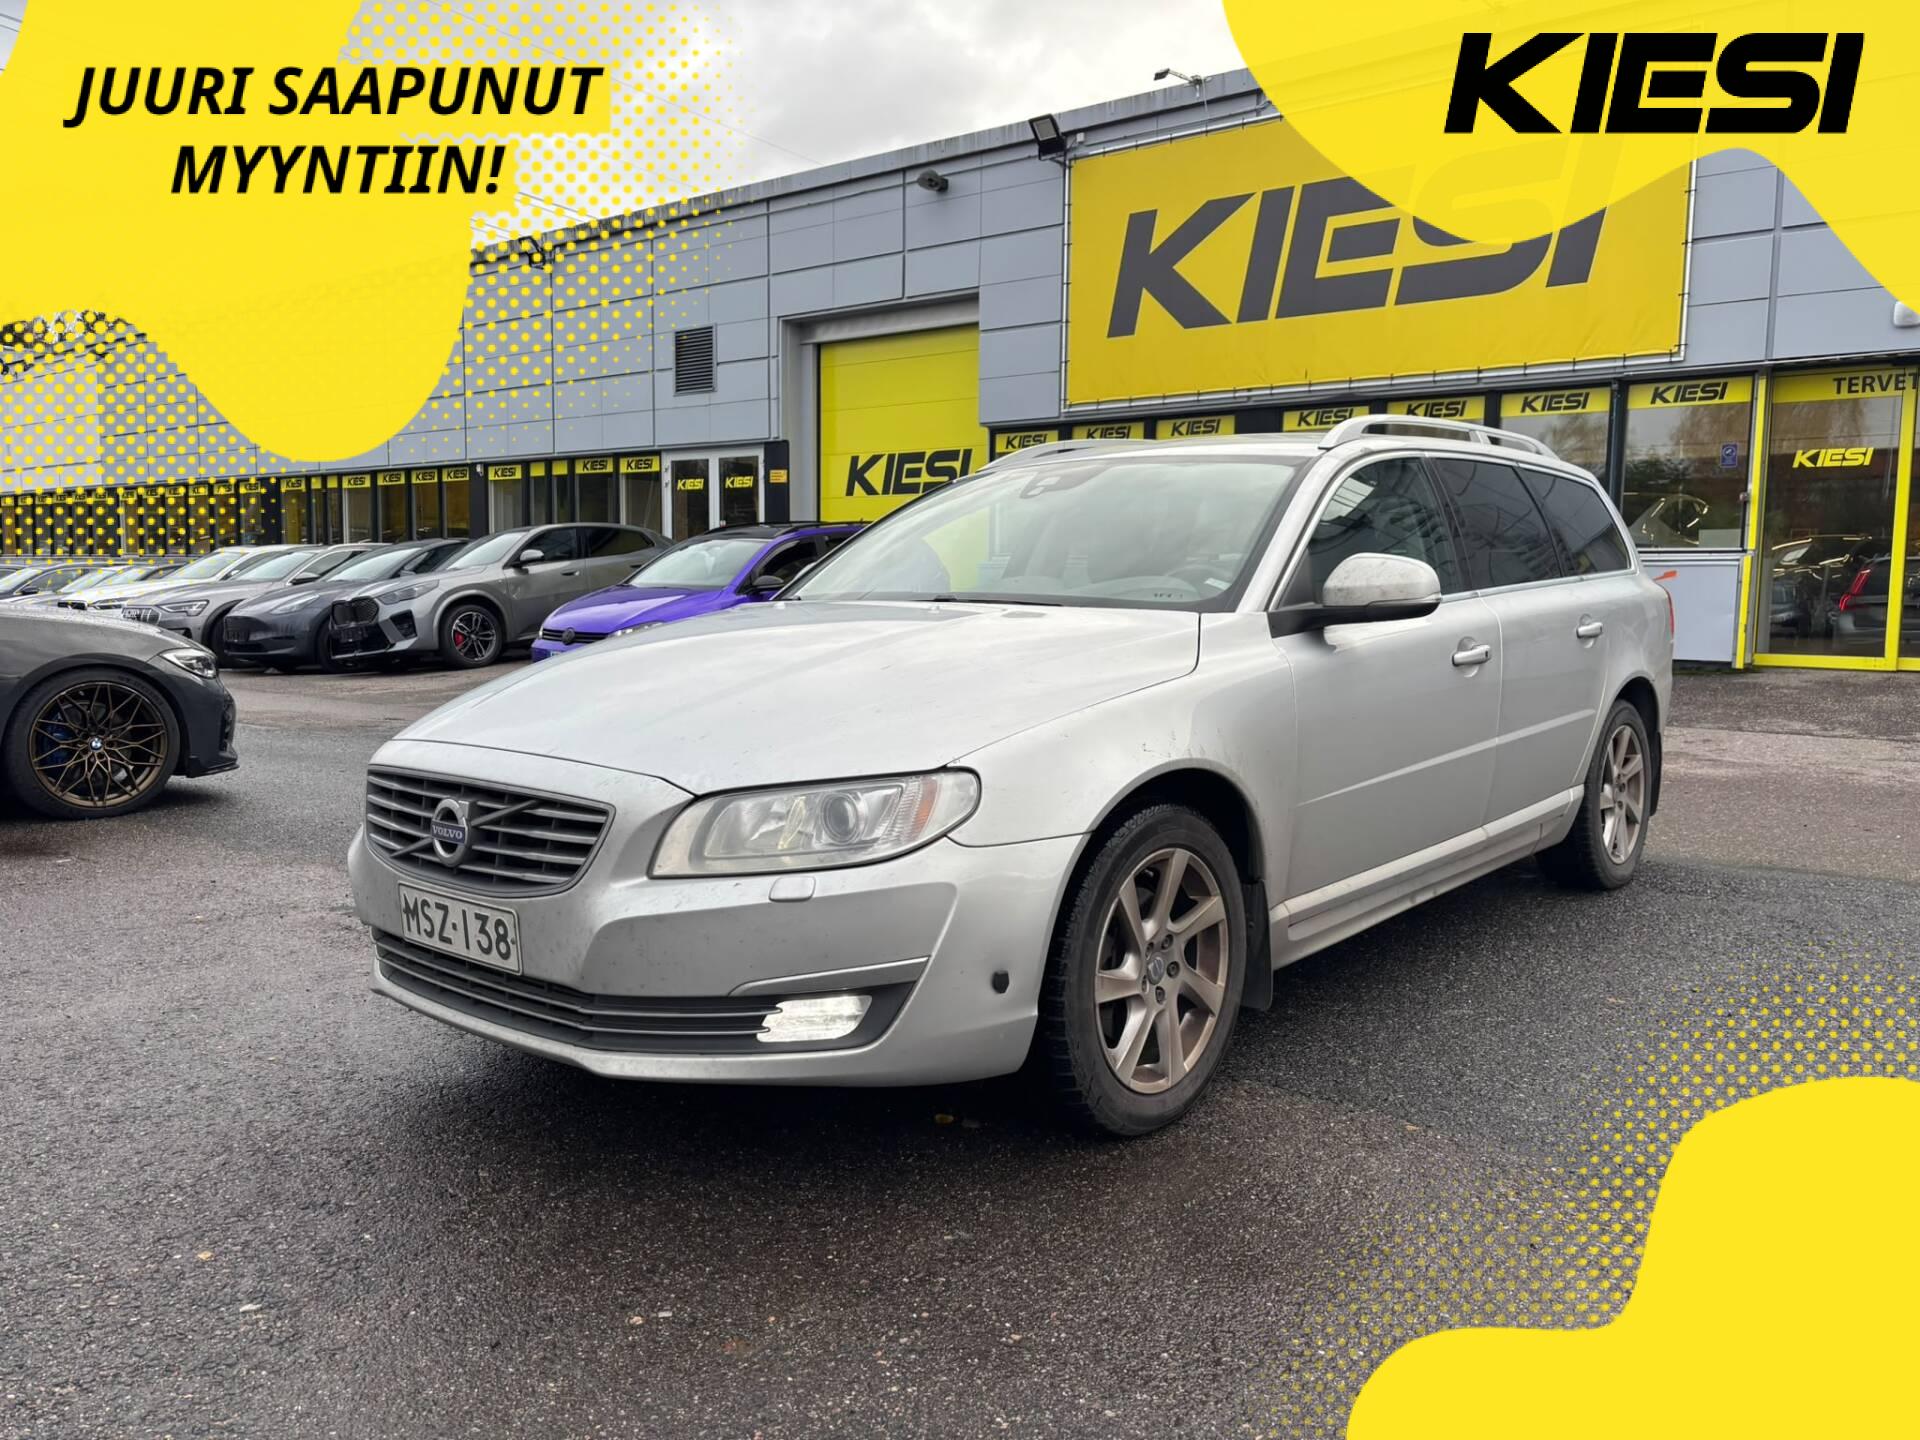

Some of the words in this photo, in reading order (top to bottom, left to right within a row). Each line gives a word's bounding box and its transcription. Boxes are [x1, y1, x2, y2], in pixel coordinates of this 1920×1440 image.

[1832, 372, 1920, 395] TERVET
[1650, 382, 1729, 405] KIESI
[1407, 400, 1467, 417] KIESI
[1520, 392, 1590, 413] KIESI
[1297, 408, 1354, 427] KIESI
[1086, 426, 1132, 439] KIESI
[1171, 419, 1221, 436] KIESI
[1005, 434, 1048, 449] KIESI
[582, 459, 608, 471] KIESI
[626, 458, 653, 471] KIESI
[1792, 447, 1875, 469] KIESI
[415, 471, 436, 482] KIESI
[446, 469, 468, 480] KIESI
[493, 467, 517, 479] KIESI
[846, 449, 973, 496] KIESI
[677, 478, 704, 490] KIESI
[725, 476, 754, 488] KIESI
[432, 824, 463, 840] VOLVO
